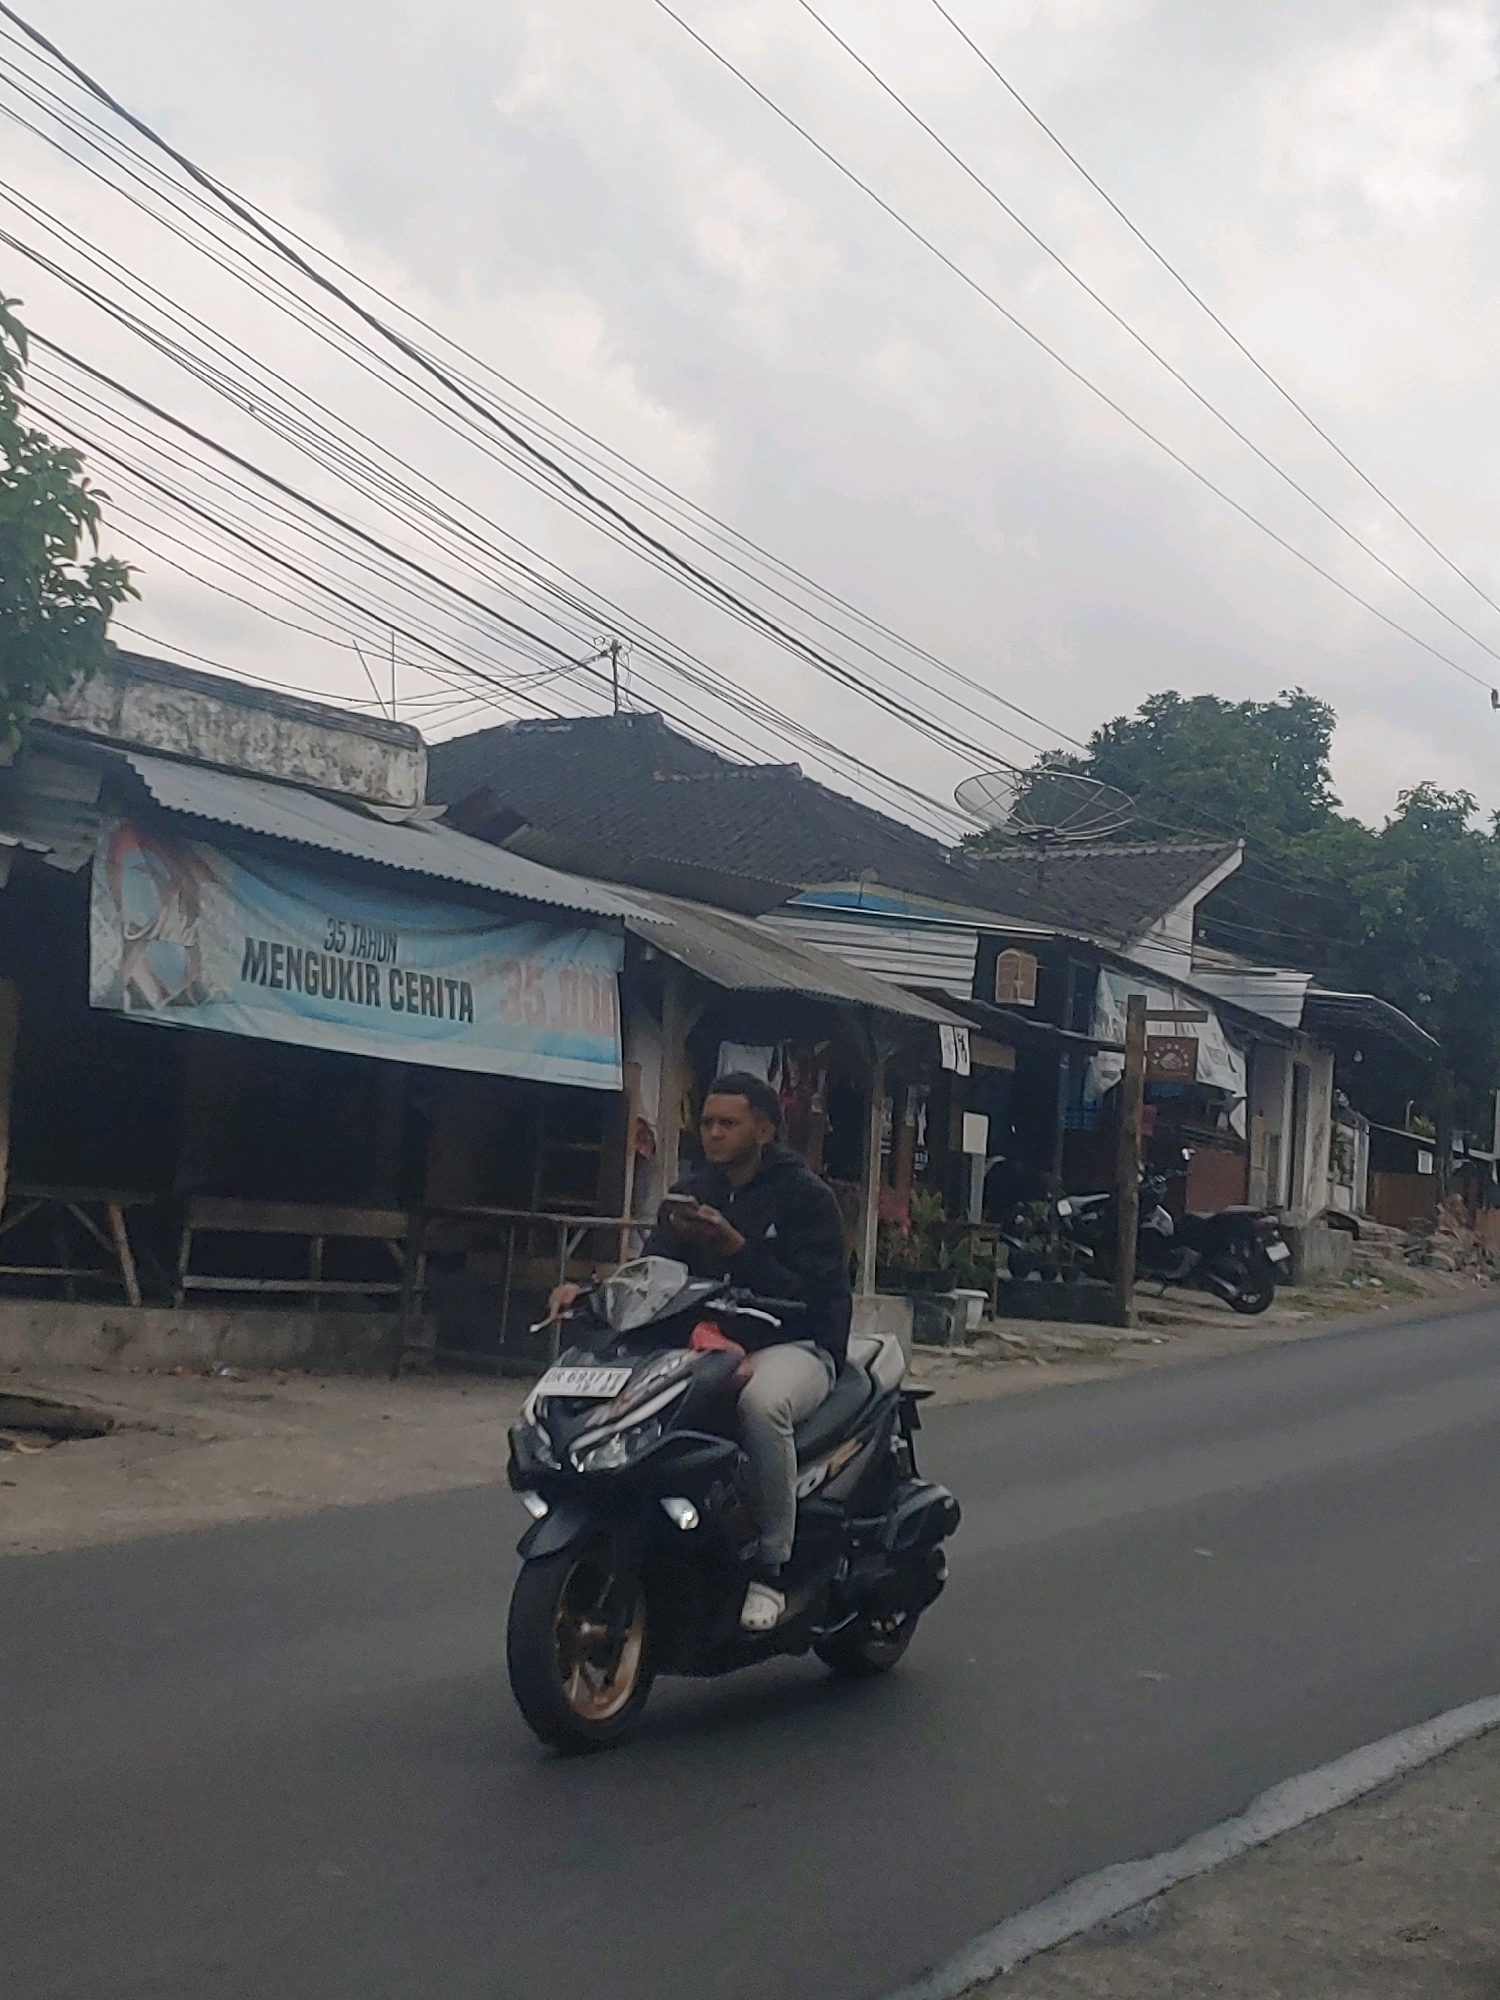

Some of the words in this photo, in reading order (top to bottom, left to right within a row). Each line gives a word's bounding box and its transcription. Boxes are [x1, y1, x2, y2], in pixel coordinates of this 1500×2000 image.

[324, 917, 347, 953] 35
[350, 922, 398, 964] TAHUN
[241, 937, 381, 1007] MENGUKIR
[389, 968, 474, 1024] CERITA
